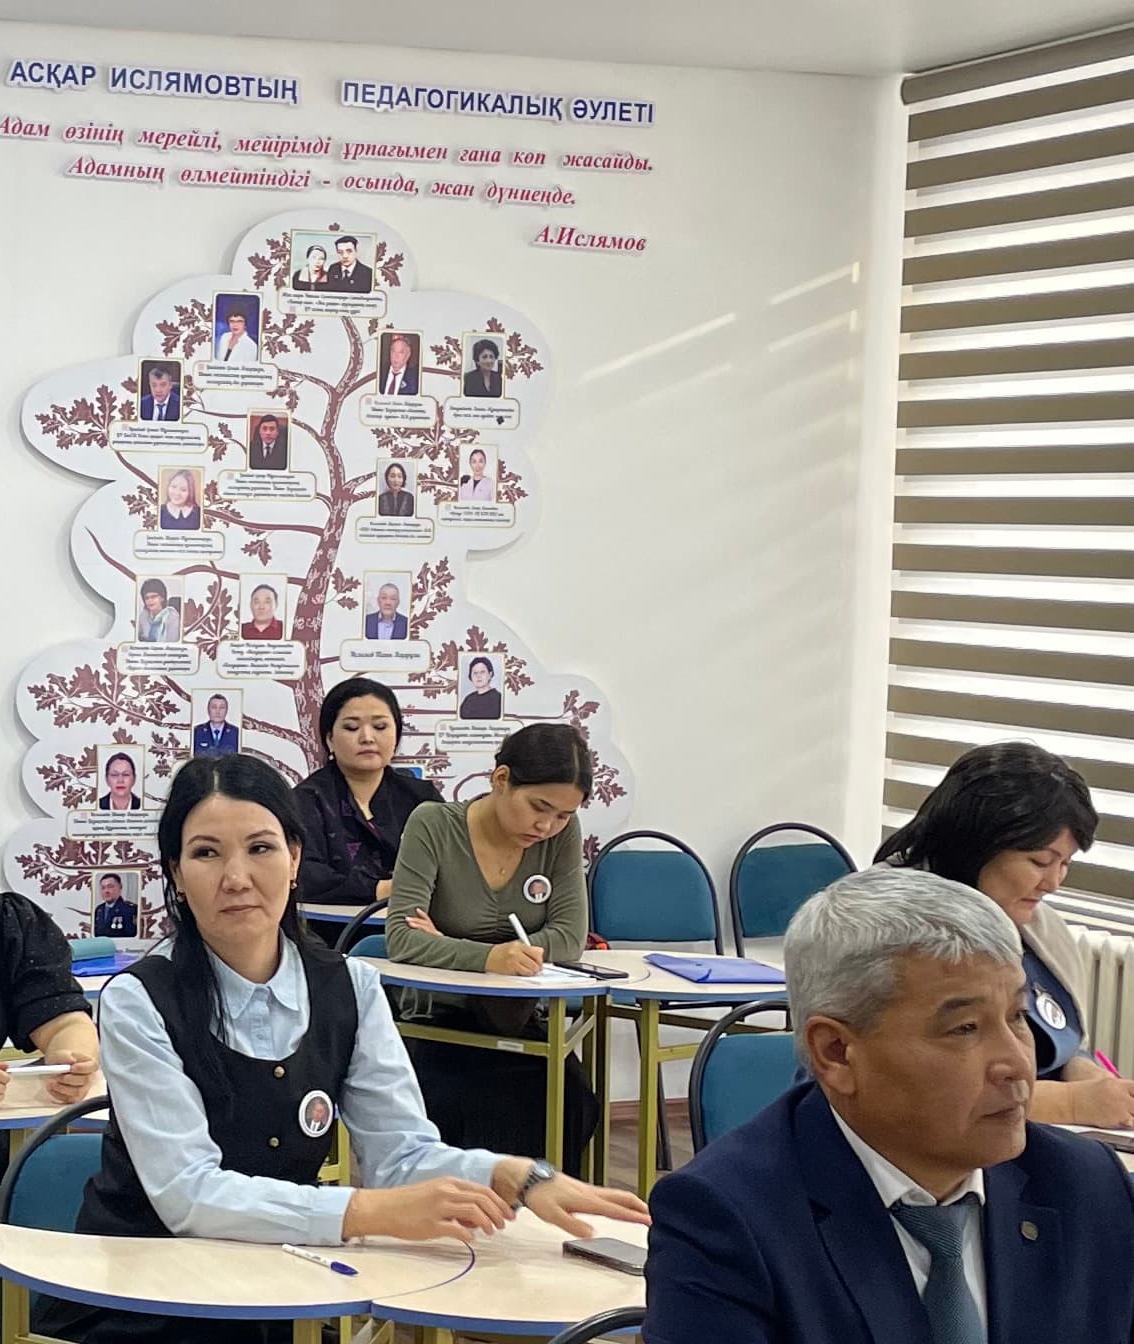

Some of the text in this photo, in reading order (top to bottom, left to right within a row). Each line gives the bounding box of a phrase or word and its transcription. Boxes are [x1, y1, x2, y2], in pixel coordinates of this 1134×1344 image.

[10, 62, 653, 123] АСҚАР ИСЛЯМОВТЫҢ ПЕДАГОГИКАЛЫҚ ӘУЛЕТІ
[65, 122, 124, 144] өзінің
[138, 128, 222, 151] мерейлі,
[234, 135, 330, 158] мейірімді
[562, 153, 653, 171] жасайды.
[69, 156, 164, 182] Адамның
[180, 168, 310, 187] өлмейтіндігі
[344, 172, 419, 195] осында,
[431, 181, 474, 197] жан
[487, 181, 576, 205] дүниеңде.
[535, 225, 646, 252] А.Ислямов
